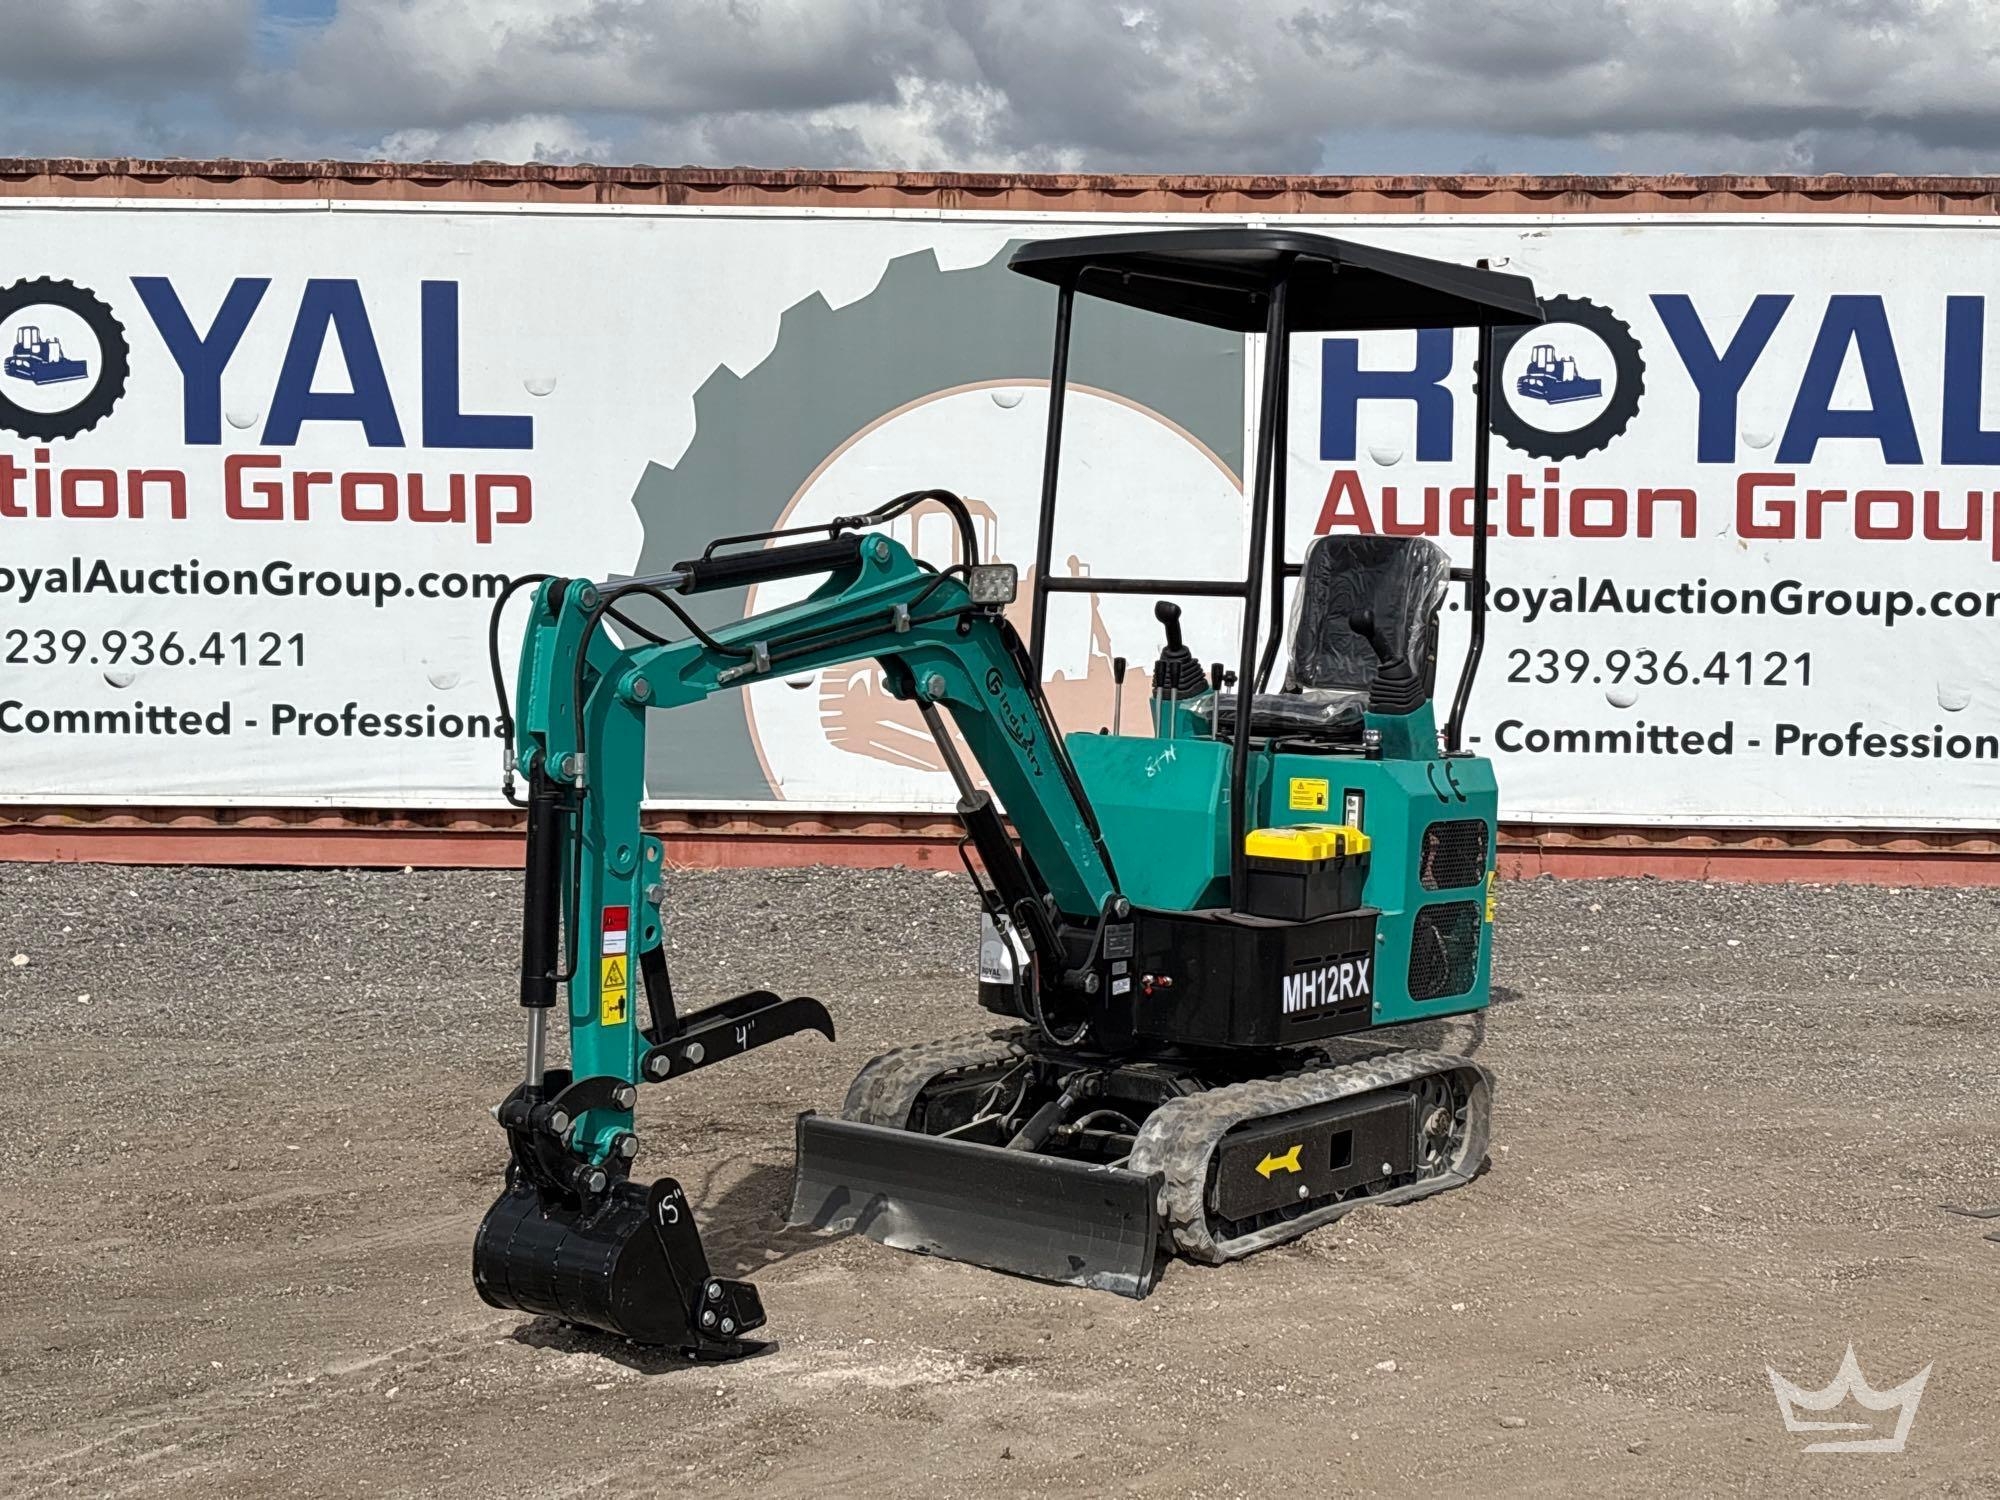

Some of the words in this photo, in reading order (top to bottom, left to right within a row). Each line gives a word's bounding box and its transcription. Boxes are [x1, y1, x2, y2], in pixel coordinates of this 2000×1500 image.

[224, 454, 533, 543] Group
[1314, 467, 1697, 538] Auction
[1736, 473, 2000, 561] Grou
[5, 629, 304, 666] 239.936.4121
[1507, 648, 1811, 686] 239.936.4121
[0, 700, 230, 735] Committed
[1495, 719, 1733, 755] Committed
[1282, 958, 1370, 1014] MH12RX
